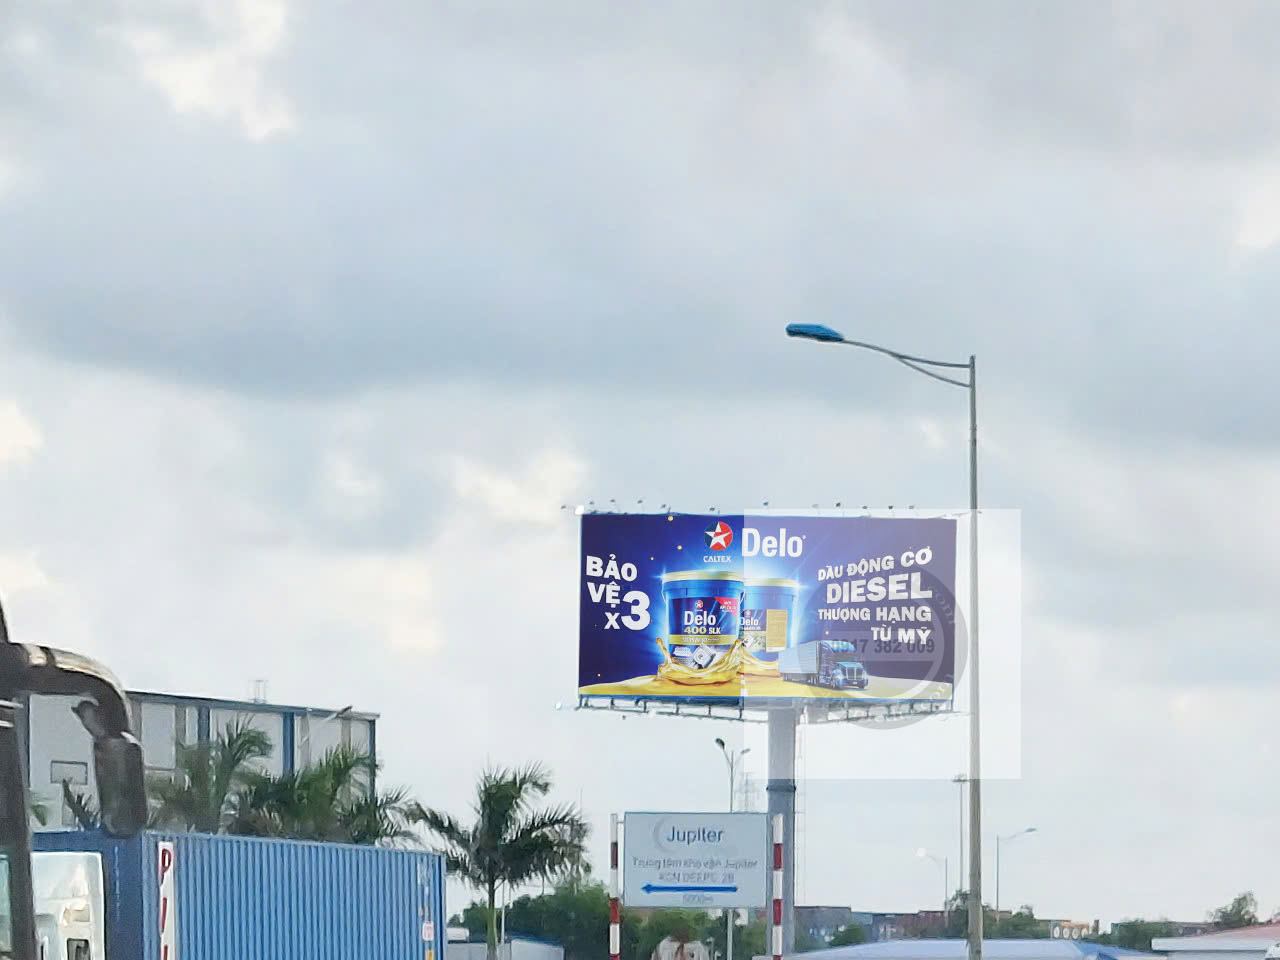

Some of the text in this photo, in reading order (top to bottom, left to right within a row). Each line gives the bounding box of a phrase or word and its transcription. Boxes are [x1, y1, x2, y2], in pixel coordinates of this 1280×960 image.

[741, 528, 803, 558] Delo
[586, 554, 638, 582] BẢO
[703, 555, 732, 563] CALTEX
[817, 546, 933, 581] DẦU ĐỘNG CƠ
[586, 581, 621, 609] VỆ
[826, 571, 933, 604] DIESEL
[684, 611, 717, 626] Delo
[818, 606, 932, 624] THƯỢNG HẠNG
[683, 626, 707, 635] 400
[871, 624, 932, 645] TỪ MỸ
[666, 826, 724, 846] Jupiter
